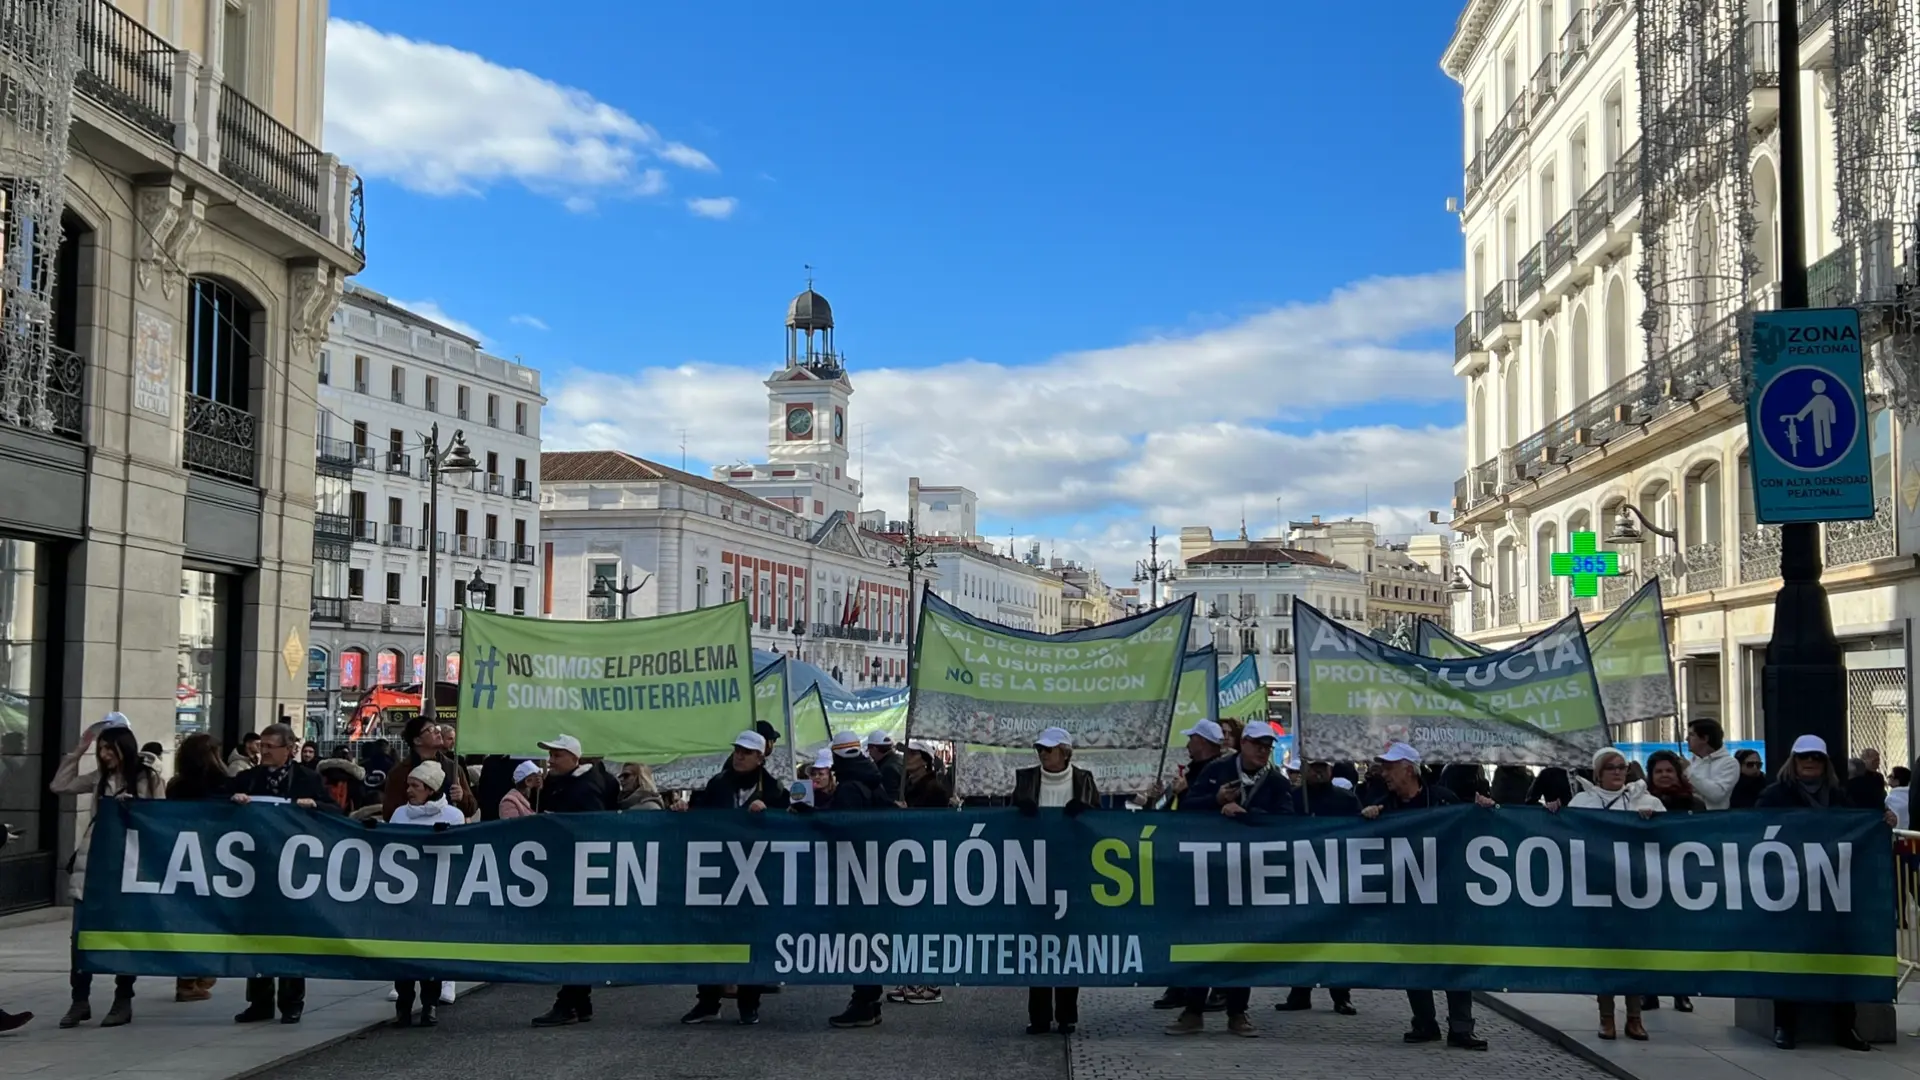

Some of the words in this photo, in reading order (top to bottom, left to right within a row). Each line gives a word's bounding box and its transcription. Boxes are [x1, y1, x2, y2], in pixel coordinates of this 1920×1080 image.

[1788, 325, 1857, 342] ZONA
[1788, 344, 1858, 355] PEATONAL
[1760, 478, 1783, 487] CON
[1786, 478, 1812, 487] ALTA
[1815, 475, 1868, 485] DENSIDAD
[1788, 488, 1845, 498] PEATONAL
[1572, 555, 1607, 573] 365
[965, 647, 991, 666] LA
[982, 634, 1079, 660] DECRETO
[507, 644, 739, 679] NOSOMOSELPROBLEMA
[945, 666, 974, 685] NO
[979, 672, 1004, 689] ES
[1010, 675, 1037, 691] LA
[1315, 664, 1430, 687] PROTEGE
[508, 678, 741, 711] SOMOSMEDITERRANIA
[756, 683, 777, 698] 22
[1410, 692, 1466, 713] VIDA
[1525, 710, 1561, 730] AL!
[121, 828, 256, 898] LAS
[278, 834, 548, 908] COSTAS
[573, 841, 659, 907] EN
[684, 823, 1068, 920] EXTINCIÓN,
[1090, 826, 1157, 907] SÍ
[1179, 836, 1438, 907] TIENEN
[1465, 825, 1853, 912] SOLUCIÓN
[774, 932, 1144, 975] SOMOSMEDITERRANIA
